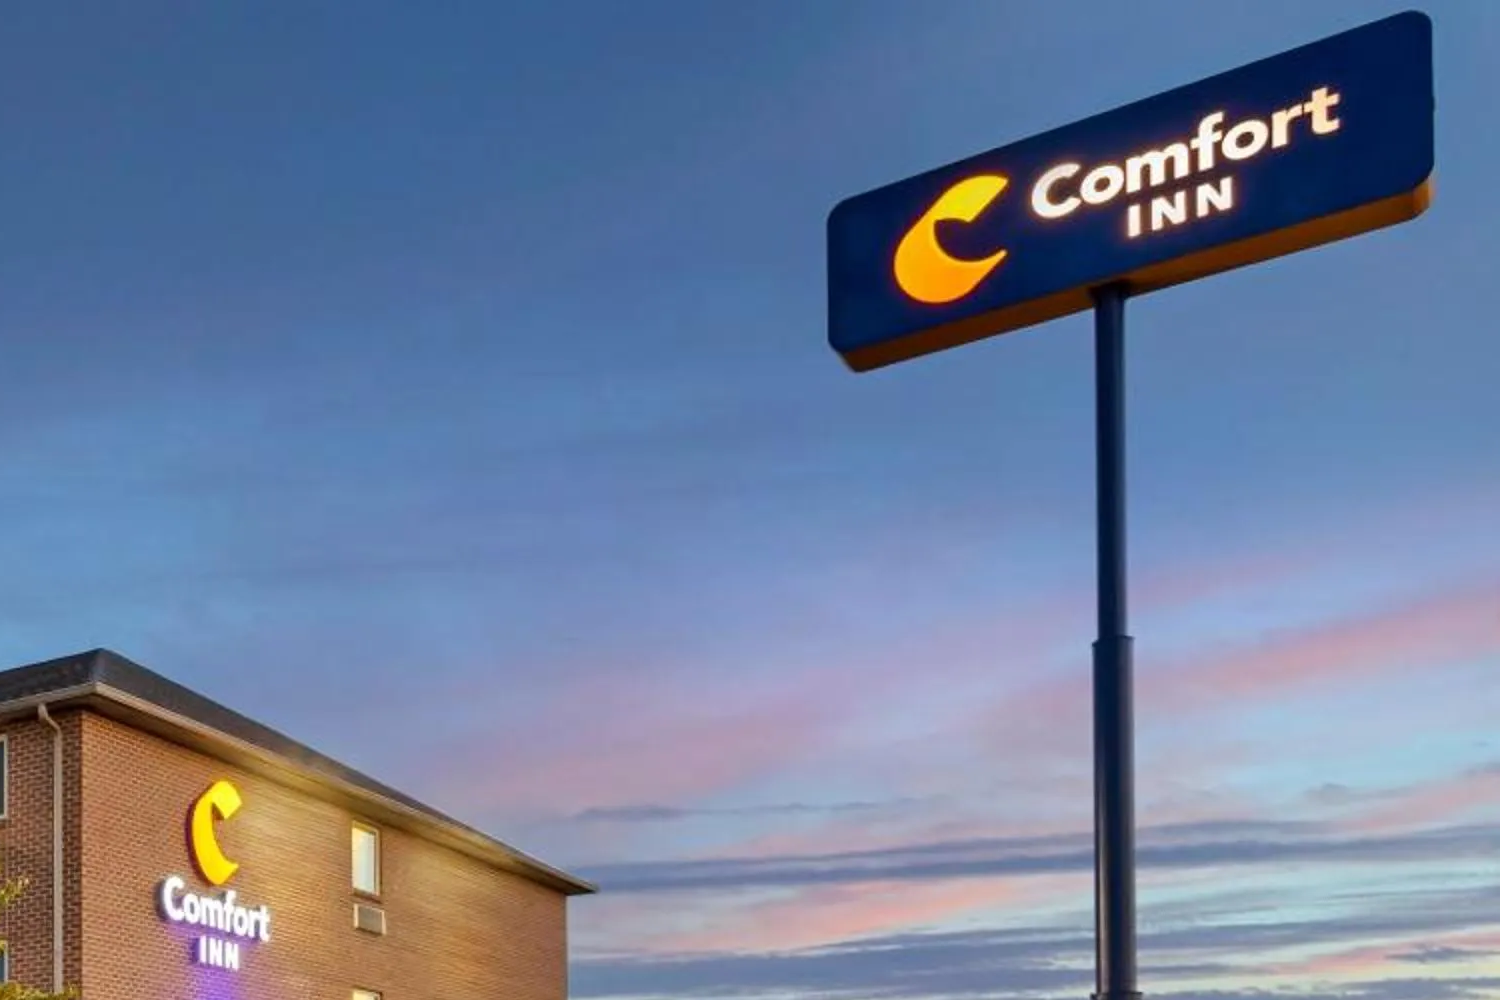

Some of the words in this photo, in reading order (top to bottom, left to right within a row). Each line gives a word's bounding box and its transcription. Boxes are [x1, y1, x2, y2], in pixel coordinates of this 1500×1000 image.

[1031, 87, 1340, 219] Comfort
[1127, 176, 1233, 238] INN
[163, 875, 270, 942] Comfort
[199, 935, 239, 971] INN
